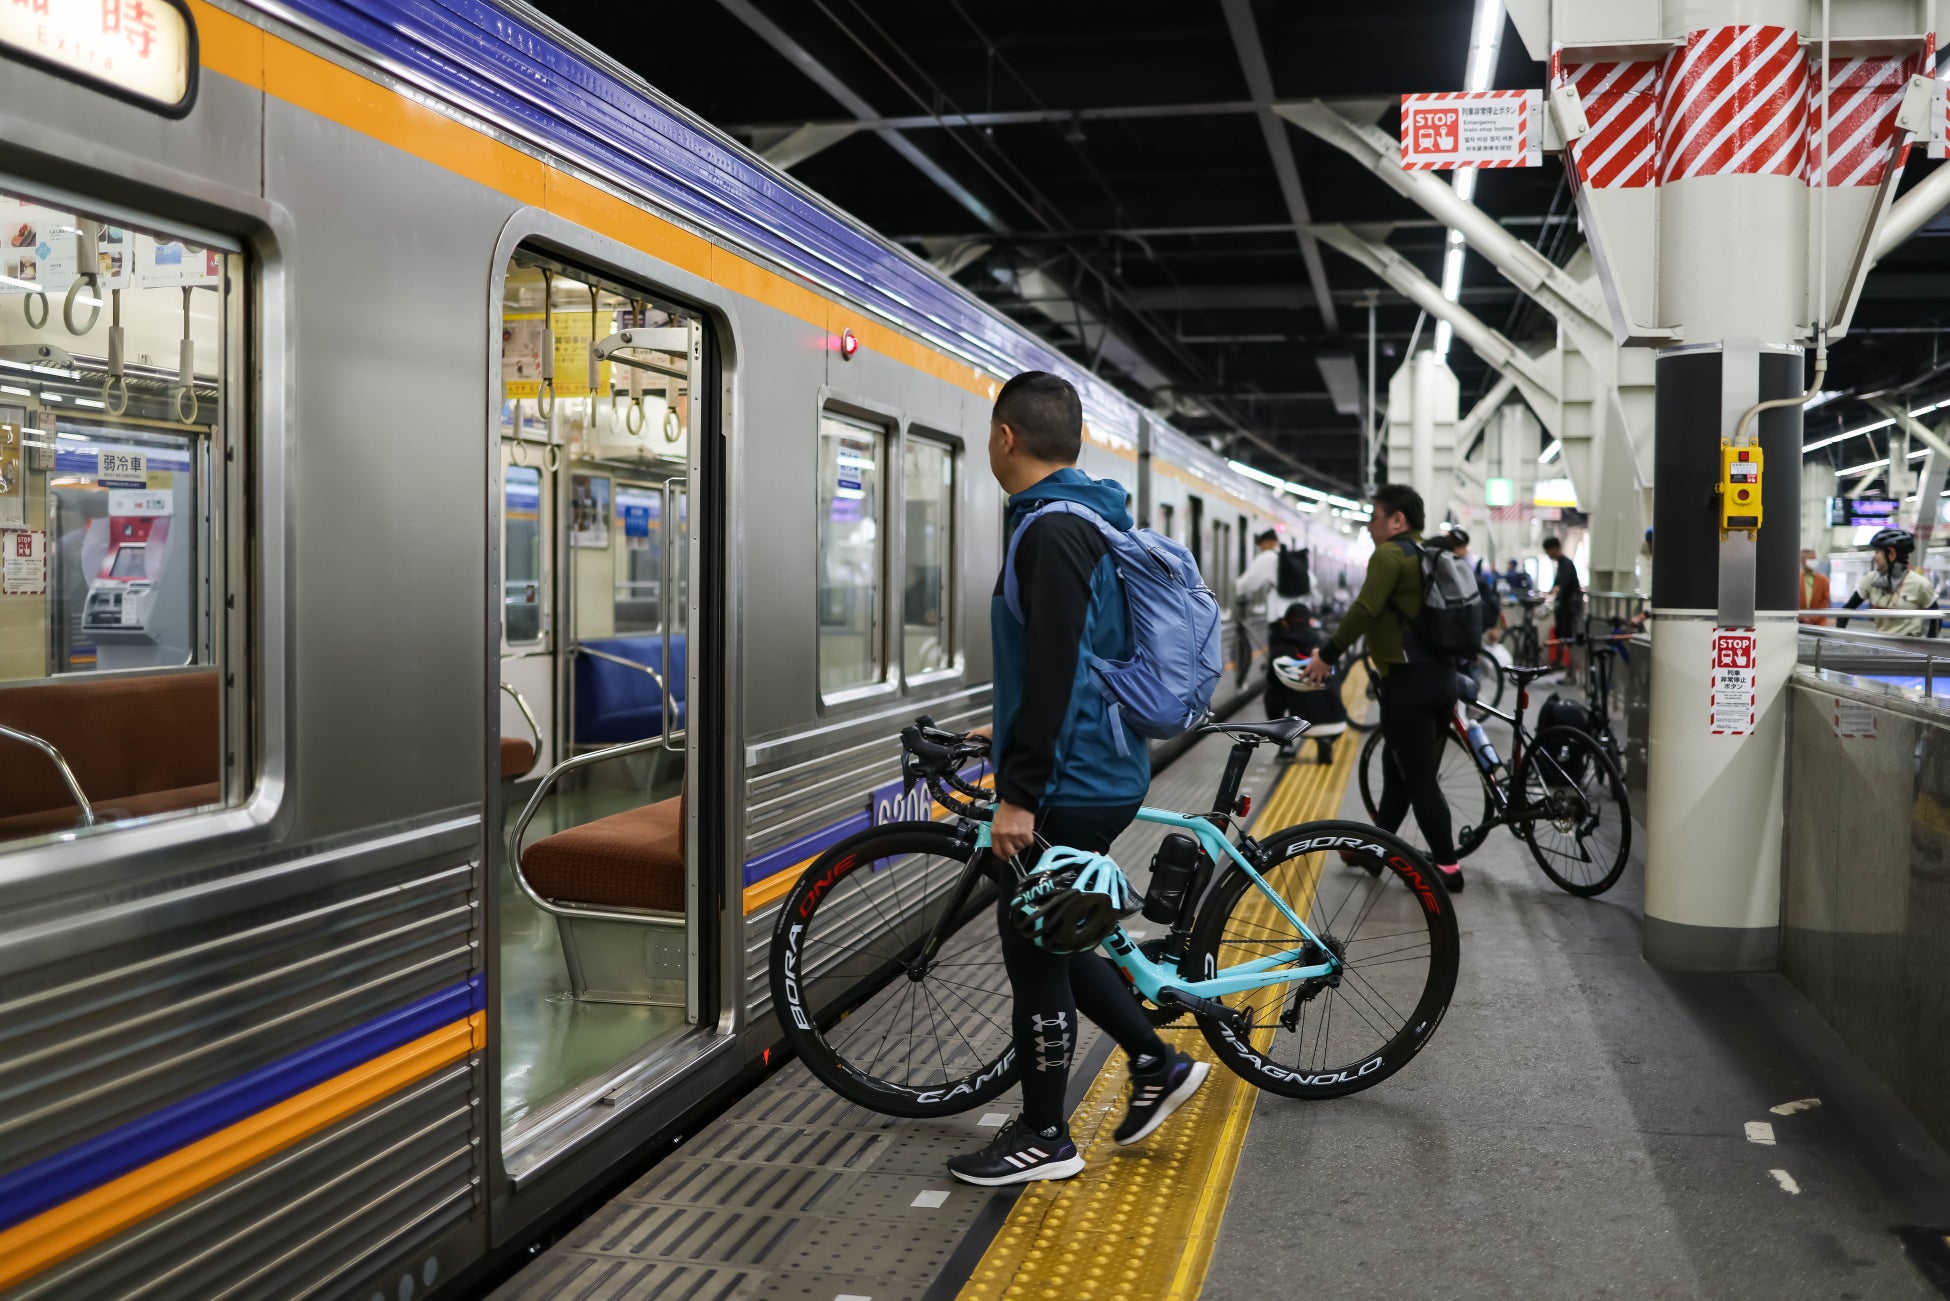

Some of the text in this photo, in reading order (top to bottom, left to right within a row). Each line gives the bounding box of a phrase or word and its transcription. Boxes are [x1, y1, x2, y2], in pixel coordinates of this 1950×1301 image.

[38, 25, 112, 70] Extra
[1415, 113, 1457, 126] STOP
[103, 454, 142, 472] 弱冷車
[1719, 639, 1750, 649] STOP
[1285, 836, 1441, 916] BORA ONE
[784, 924, 811, 1031] BORA
[800, 852, 857, 919] ONE
